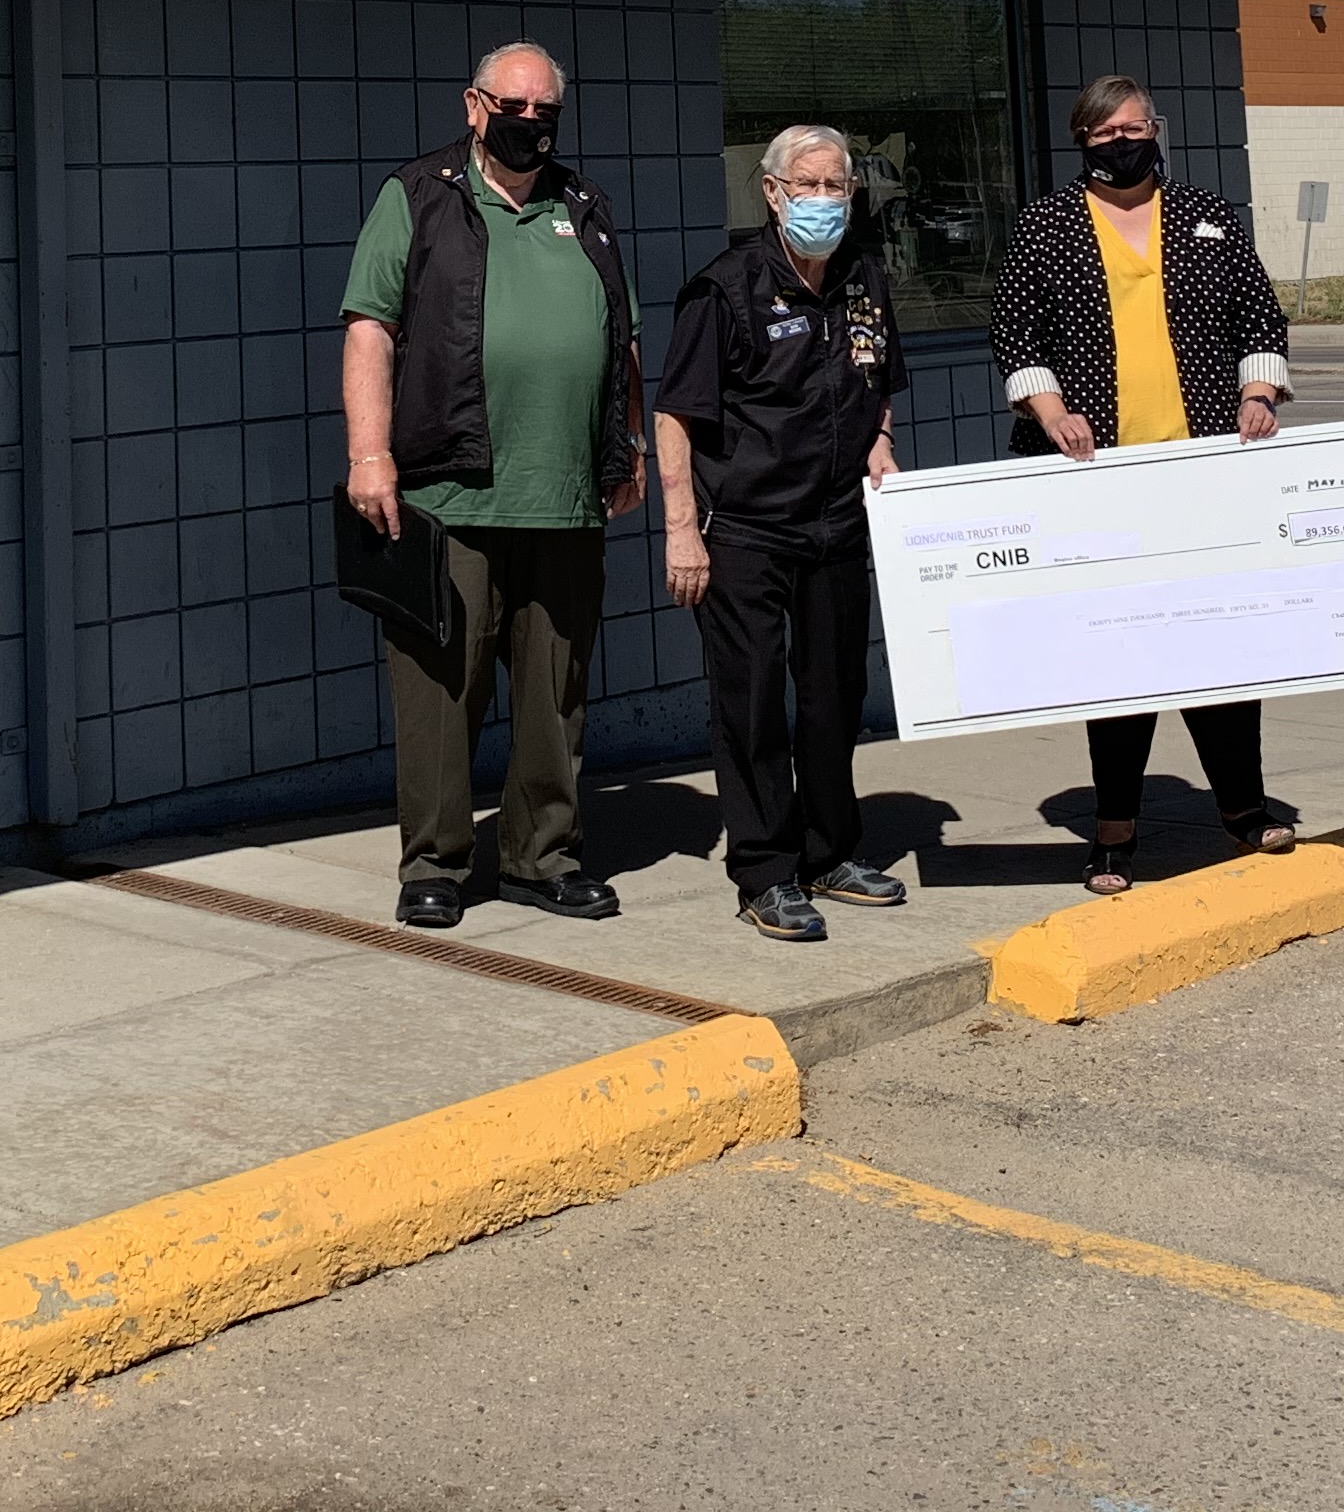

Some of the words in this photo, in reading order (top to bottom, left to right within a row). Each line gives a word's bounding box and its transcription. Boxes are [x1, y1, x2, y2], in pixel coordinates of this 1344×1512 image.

[1281, 485, 1299, 494] DATE
[1307, 479, 1335, 489] MAY
[905, 531, 965, 547] LIONS/CNIB
[967, 527, 999, 540] TRUST
[1001, 523, 1031, 536] FUND
[1278, 523, 1289, 538] $
[976, 548, 1030, 570] CNIB
[919, 566, 933, 575] PAY
[934, 564, 943, 573] TO
[945, 563, 958, 572] THE
[920, 573, 944, 582] ORDER
[945, 571, 954, 580] OF
